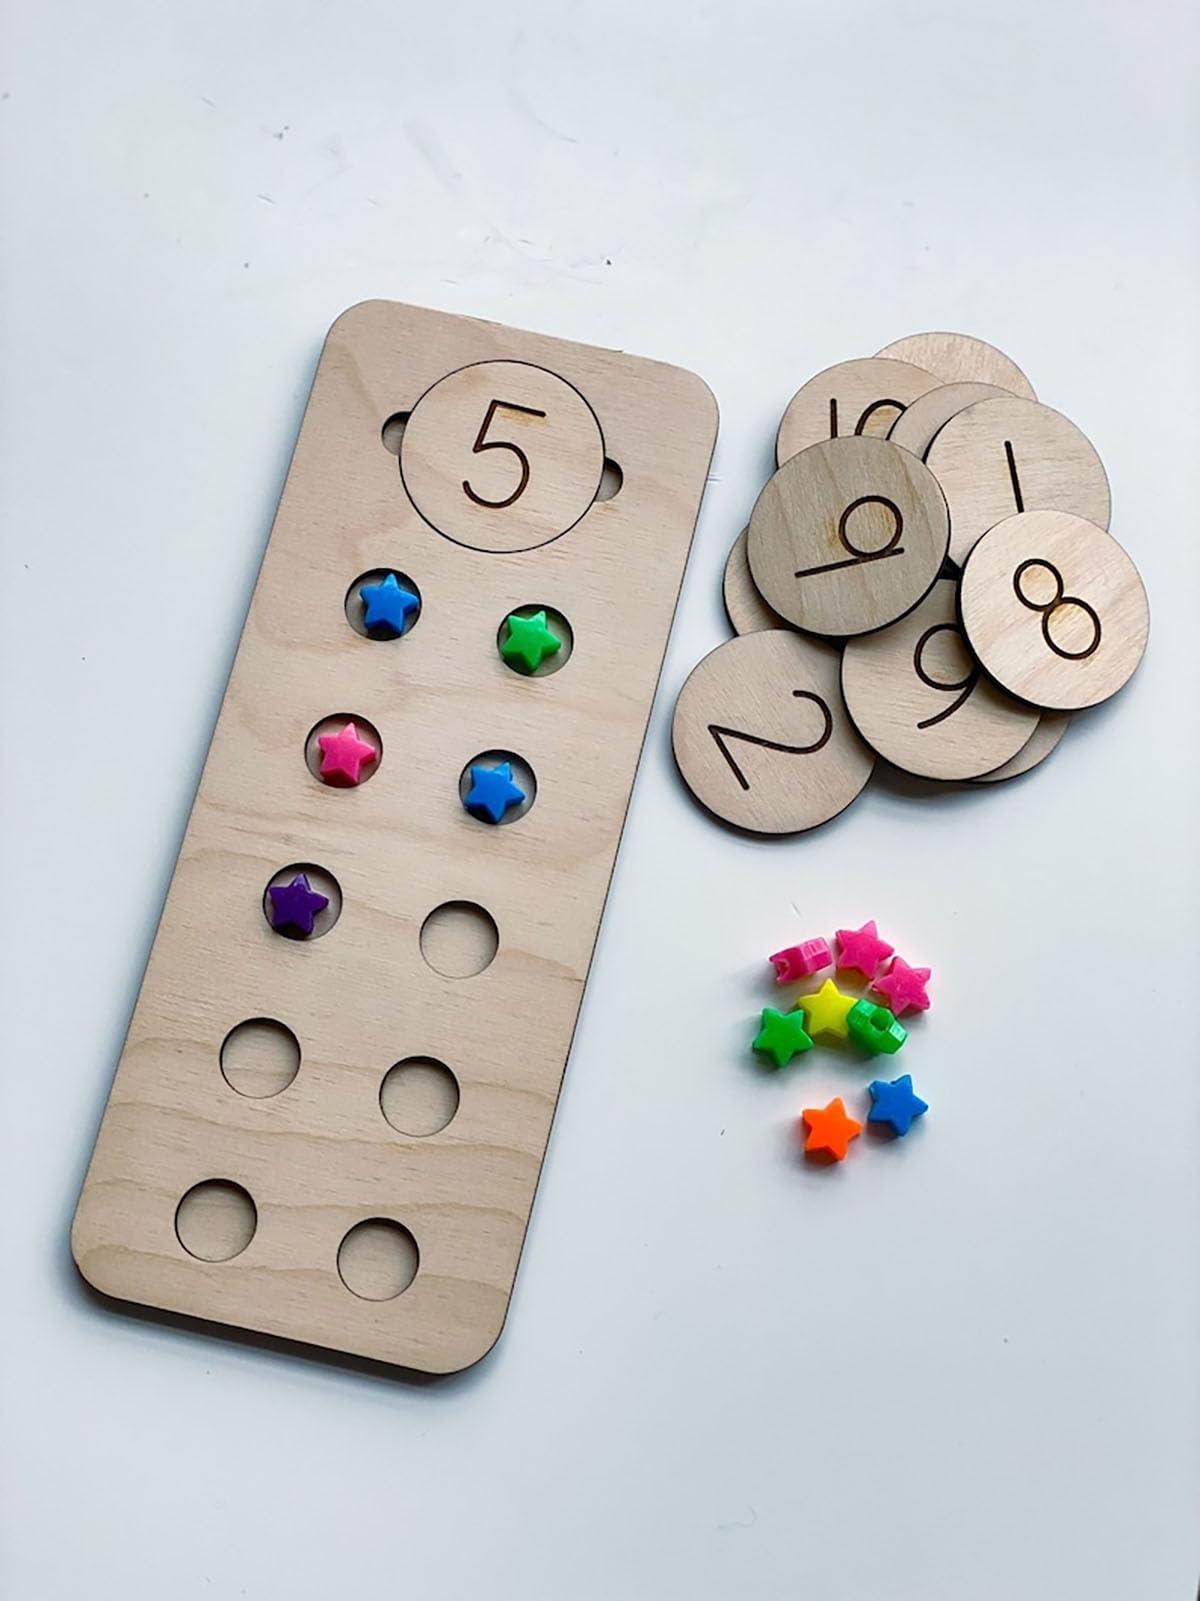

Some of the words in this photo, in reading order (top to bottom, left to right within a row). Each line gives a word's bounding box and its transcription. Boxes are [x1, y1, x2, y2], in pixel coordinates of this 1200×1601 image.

[462, 399, 546, 509] 5
[1013, 558, 1102, 660] 8
[707, 690, 833, 791] 2
